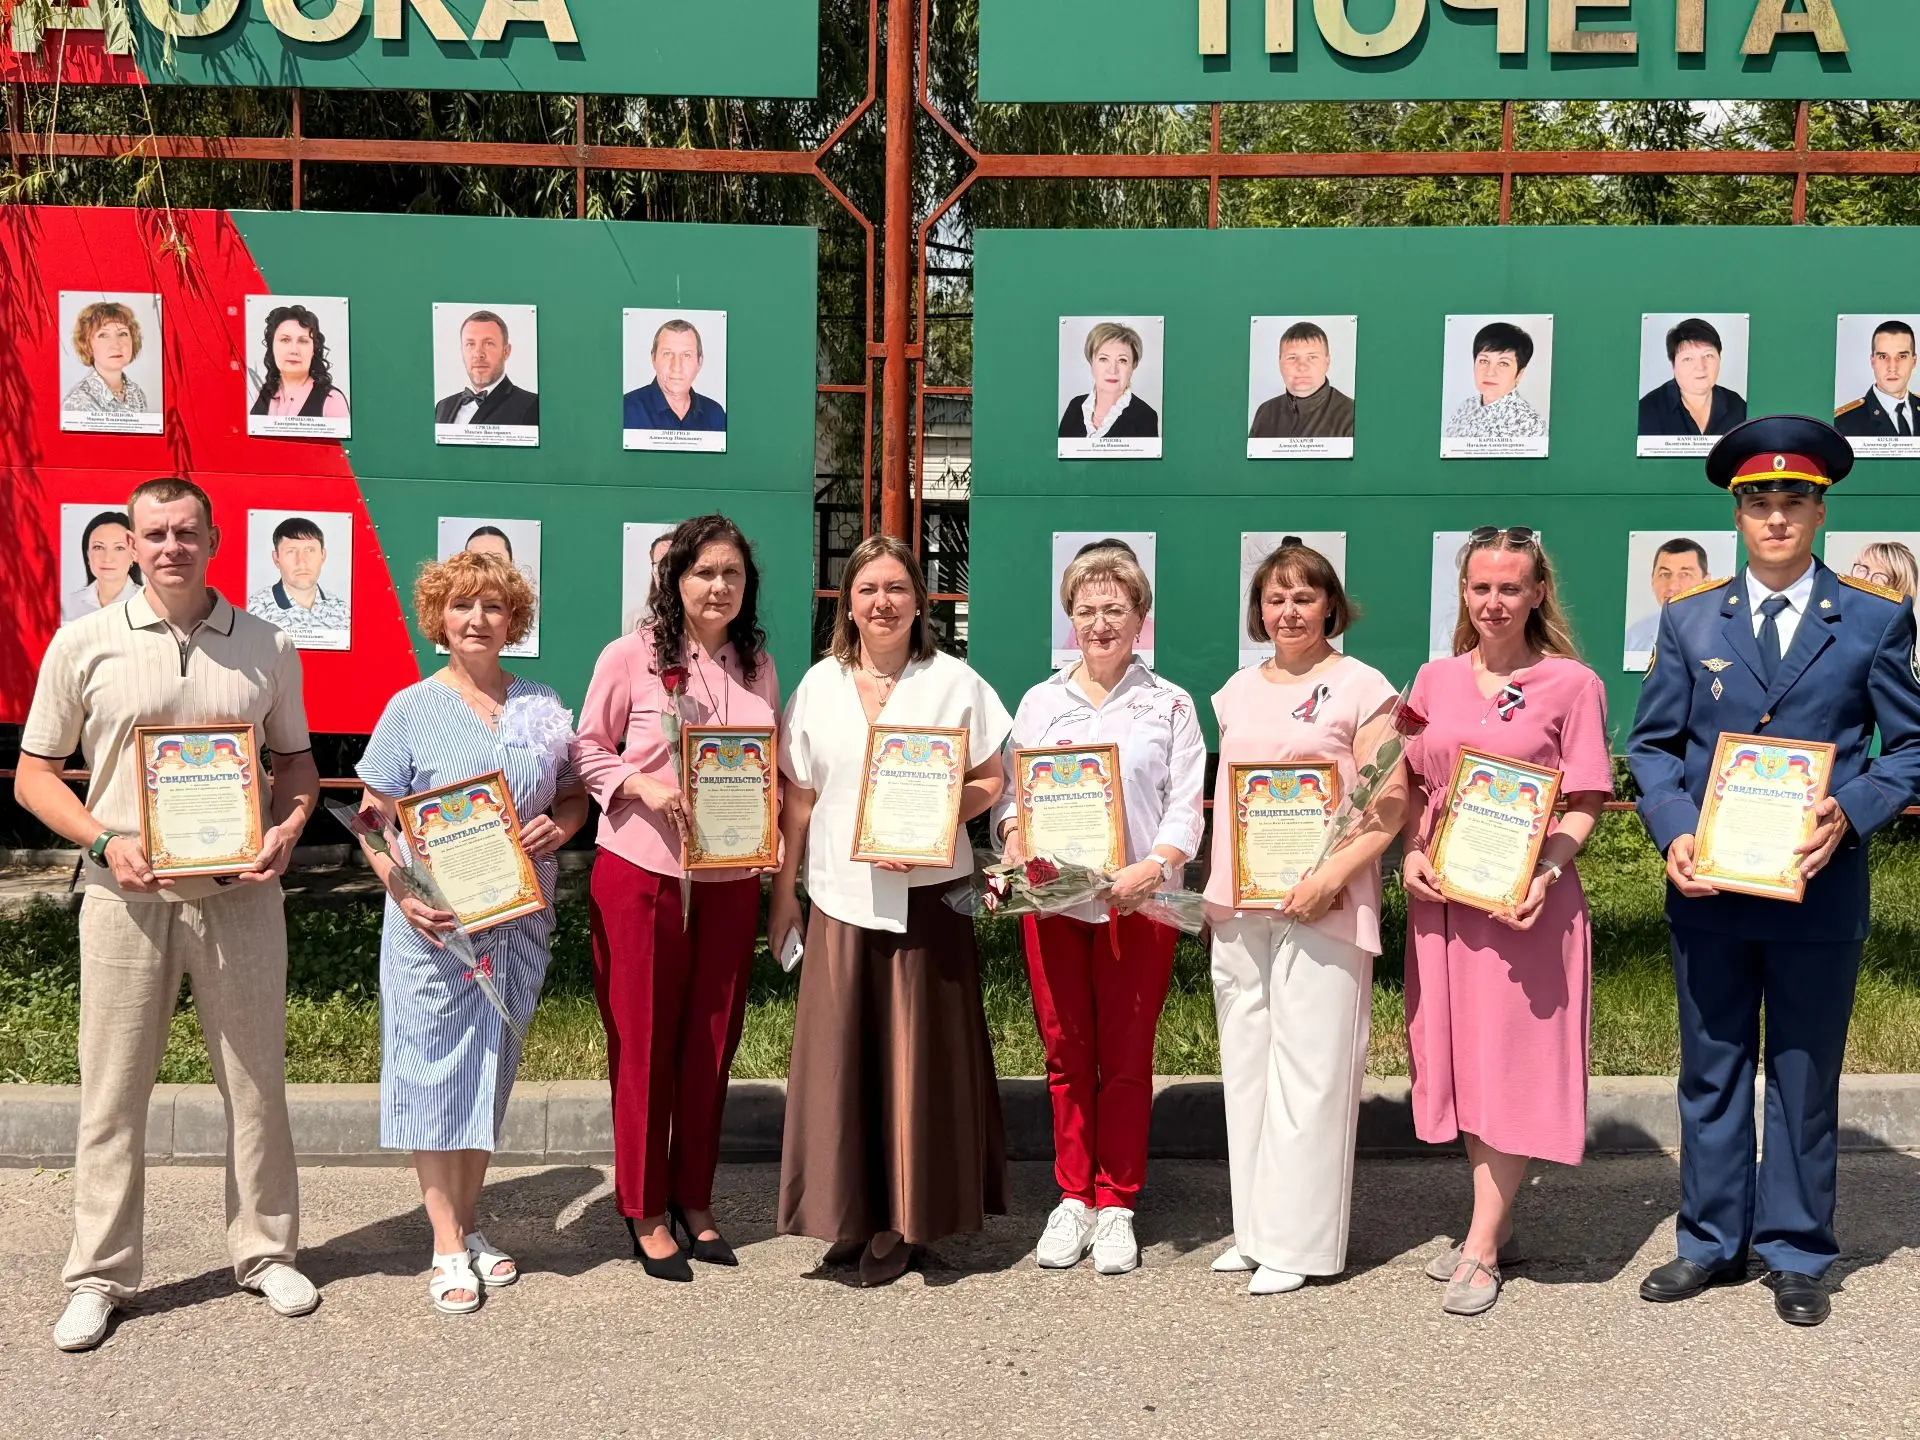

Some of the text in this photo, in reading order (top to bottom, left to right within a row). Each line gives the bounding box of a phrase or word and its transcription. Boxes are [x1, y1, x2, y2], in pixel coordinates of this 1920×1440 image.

[160, 773, 240, 784] СВИДЕТЕЛЬСТВО
[880, 769, 948, 780] СВИДЕТЕЛЬСТВО
[699, 776, 761, 785] СВИДЕТЕЛЬСТВО
[1033, 791, 1103, 803] СВИДЕТЕЛЬСТВО
[1728, 785, 1803, 800] СВИДЕТЕЛЬСТВО
[1249, 808, 1322, 818] СВИДЕТЕЛЬСТВО
[1463, 803, 1530, 828] СВИДЕТЕЛЬСТВО
[428, 820, 500, 848] СВИДЕТЕЛЬСТВО
